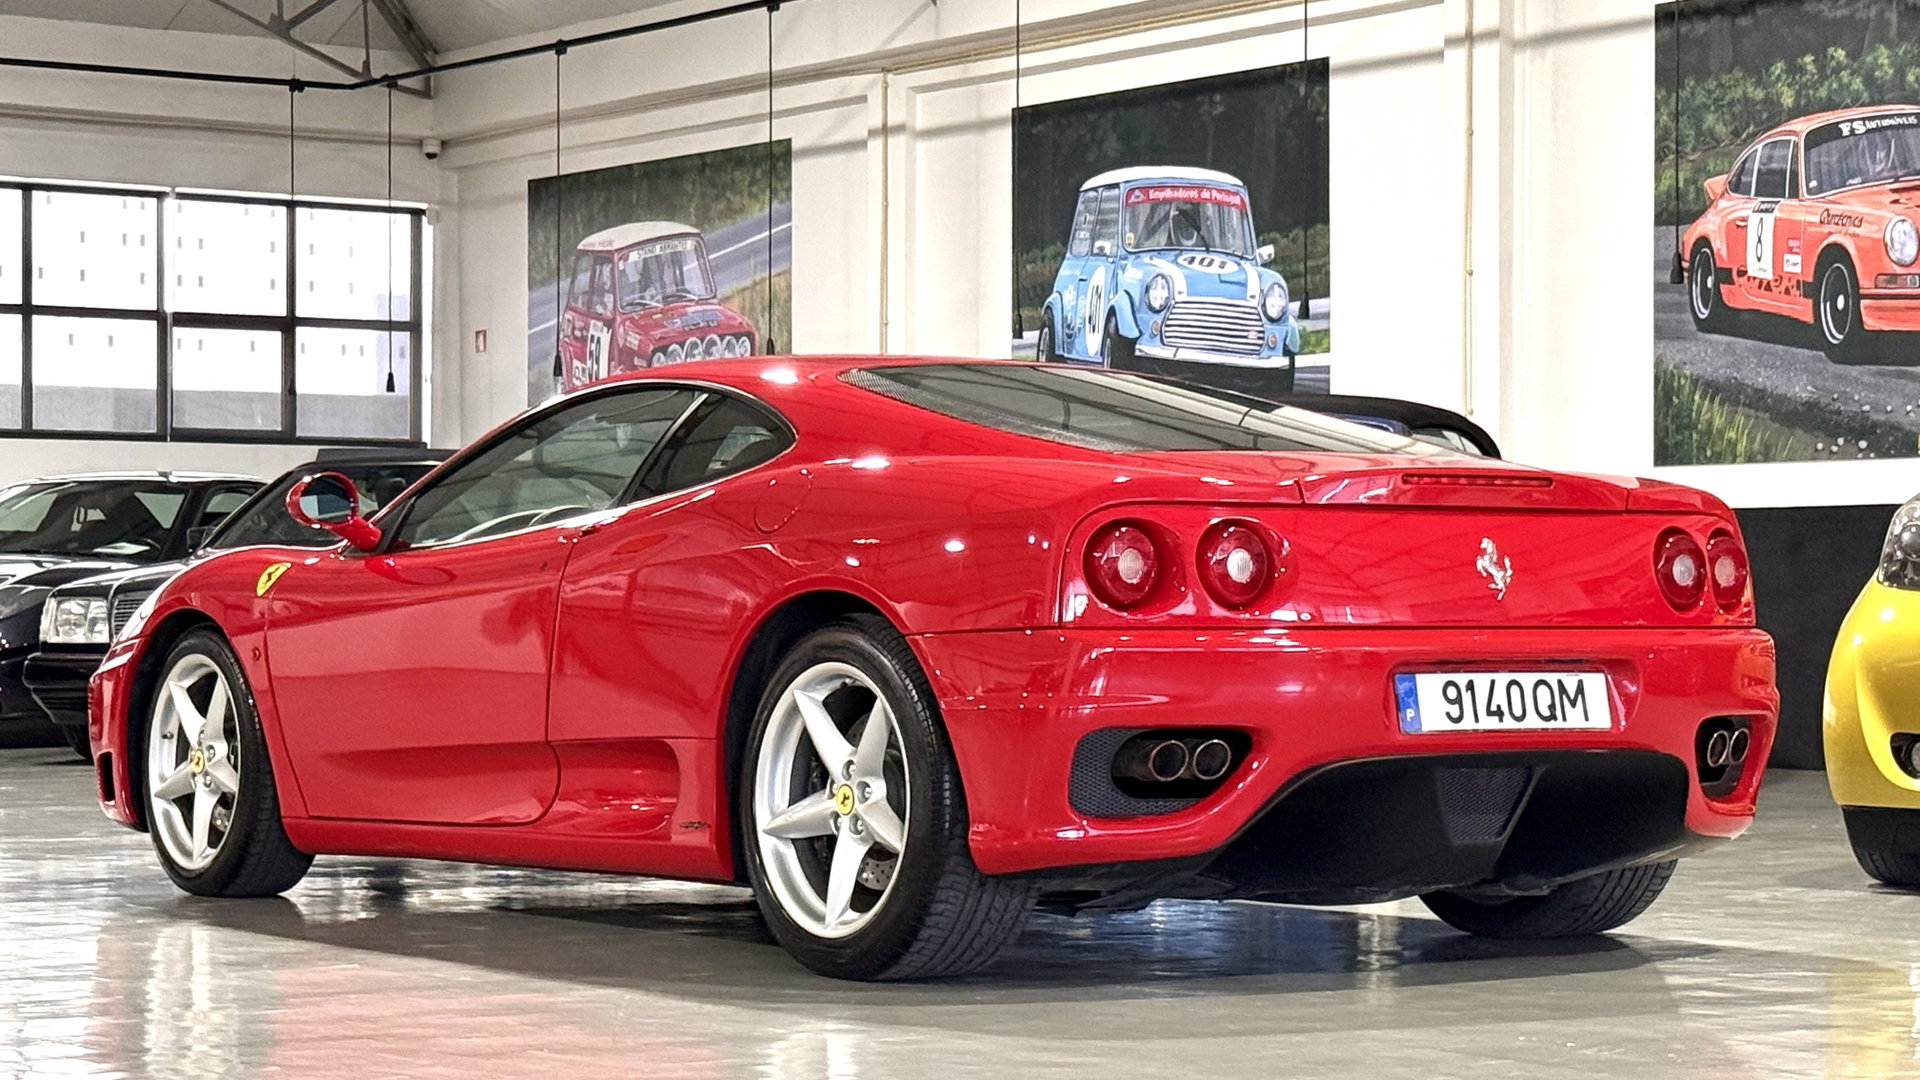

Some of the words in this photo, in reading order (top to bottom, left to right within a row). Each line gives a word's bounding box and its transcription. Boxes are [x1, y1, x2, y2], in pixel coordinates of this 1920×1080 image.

[1838, 121, 1866, 136] FS
[1755, 217, 1764, 263] 8
[1182, 255, 1228, 270] 401
[1088, 284, 1104, 335] 401
[1406, 708, 1415, 721] P
[1442, 678, 1589, 724] 9140QM
